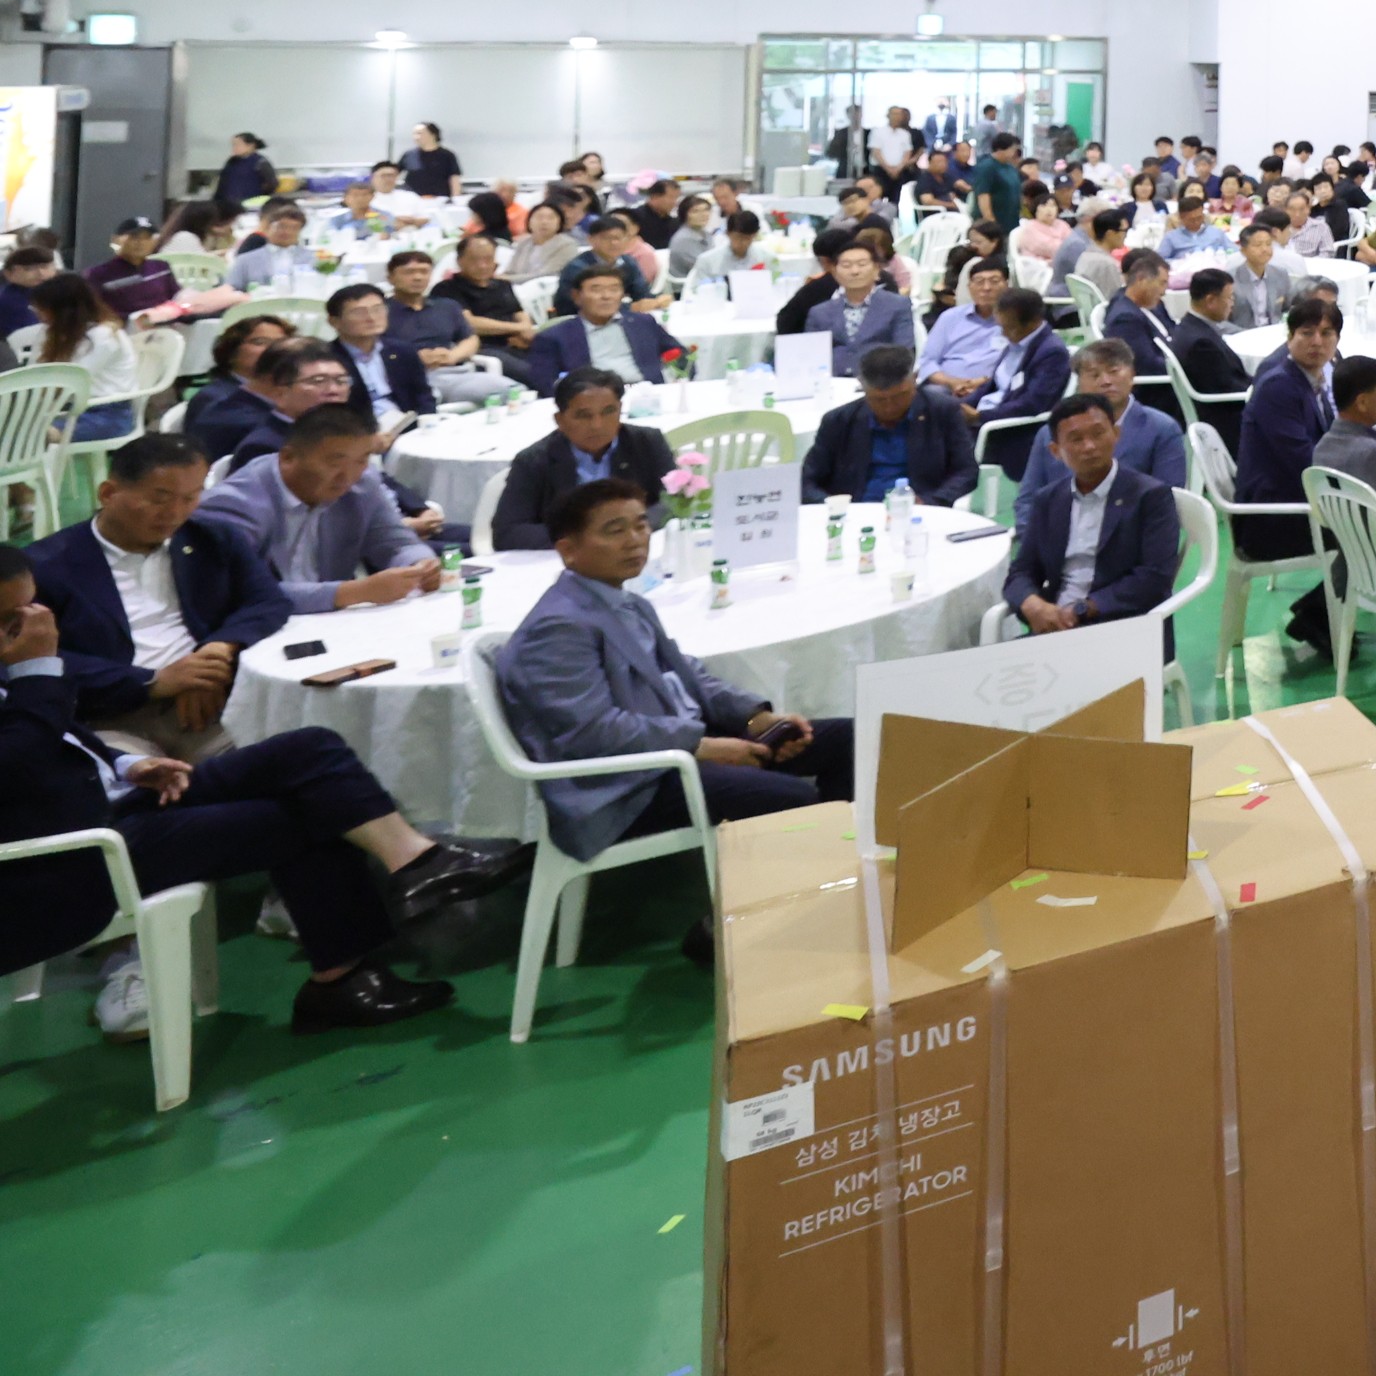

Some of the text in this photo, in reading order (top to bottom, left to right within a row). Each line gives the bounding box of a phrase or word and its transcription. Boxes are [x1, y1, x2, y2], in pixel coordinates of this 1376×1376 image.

[781, 1015, 977, 1090] SAMSUNG
[795, 1136, 838, 1169] 삼성
[898, 1100, 962, 1136] 냉장고
